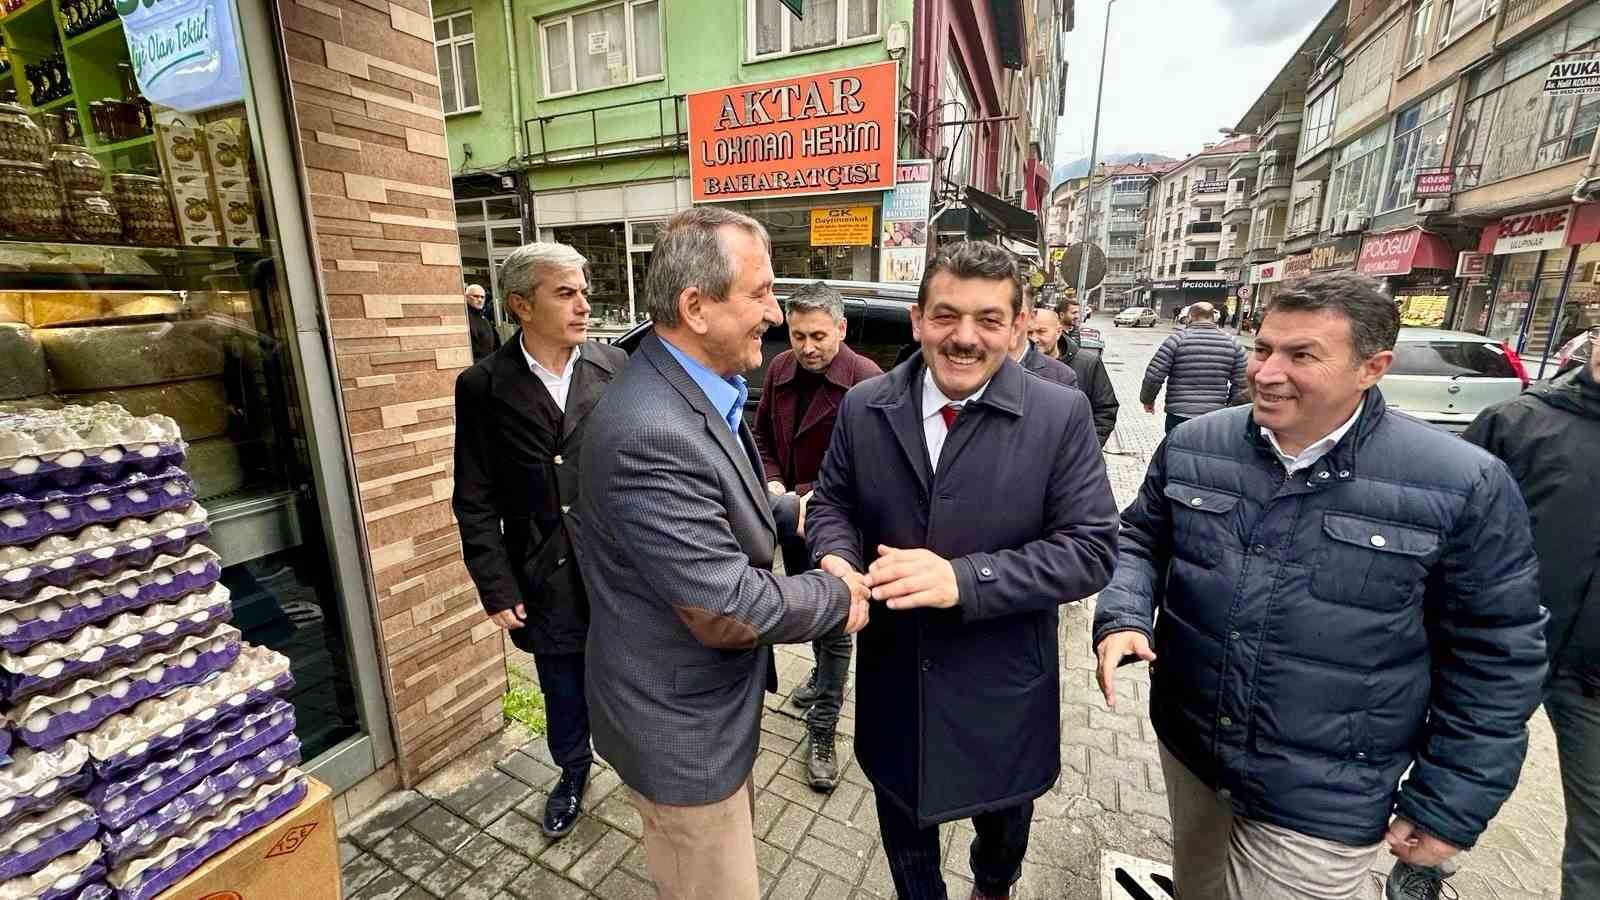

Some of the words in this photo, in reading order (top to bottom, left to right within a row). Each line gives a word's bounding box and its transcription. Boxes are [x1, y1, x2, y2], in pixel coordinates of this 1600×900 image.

[148, 35, 175, 62] Olan
[175, 8, 208, 51] Tektir!
[1549, 61, 1600, 78] AVUKA
[714, 77, 864, 131] AKTAR
[702, 131, 793, 166] LOKMAN
[704, 162, 881, 195] BAHARATÇISI
[1497, 208, 1569, 239] ECZANE
